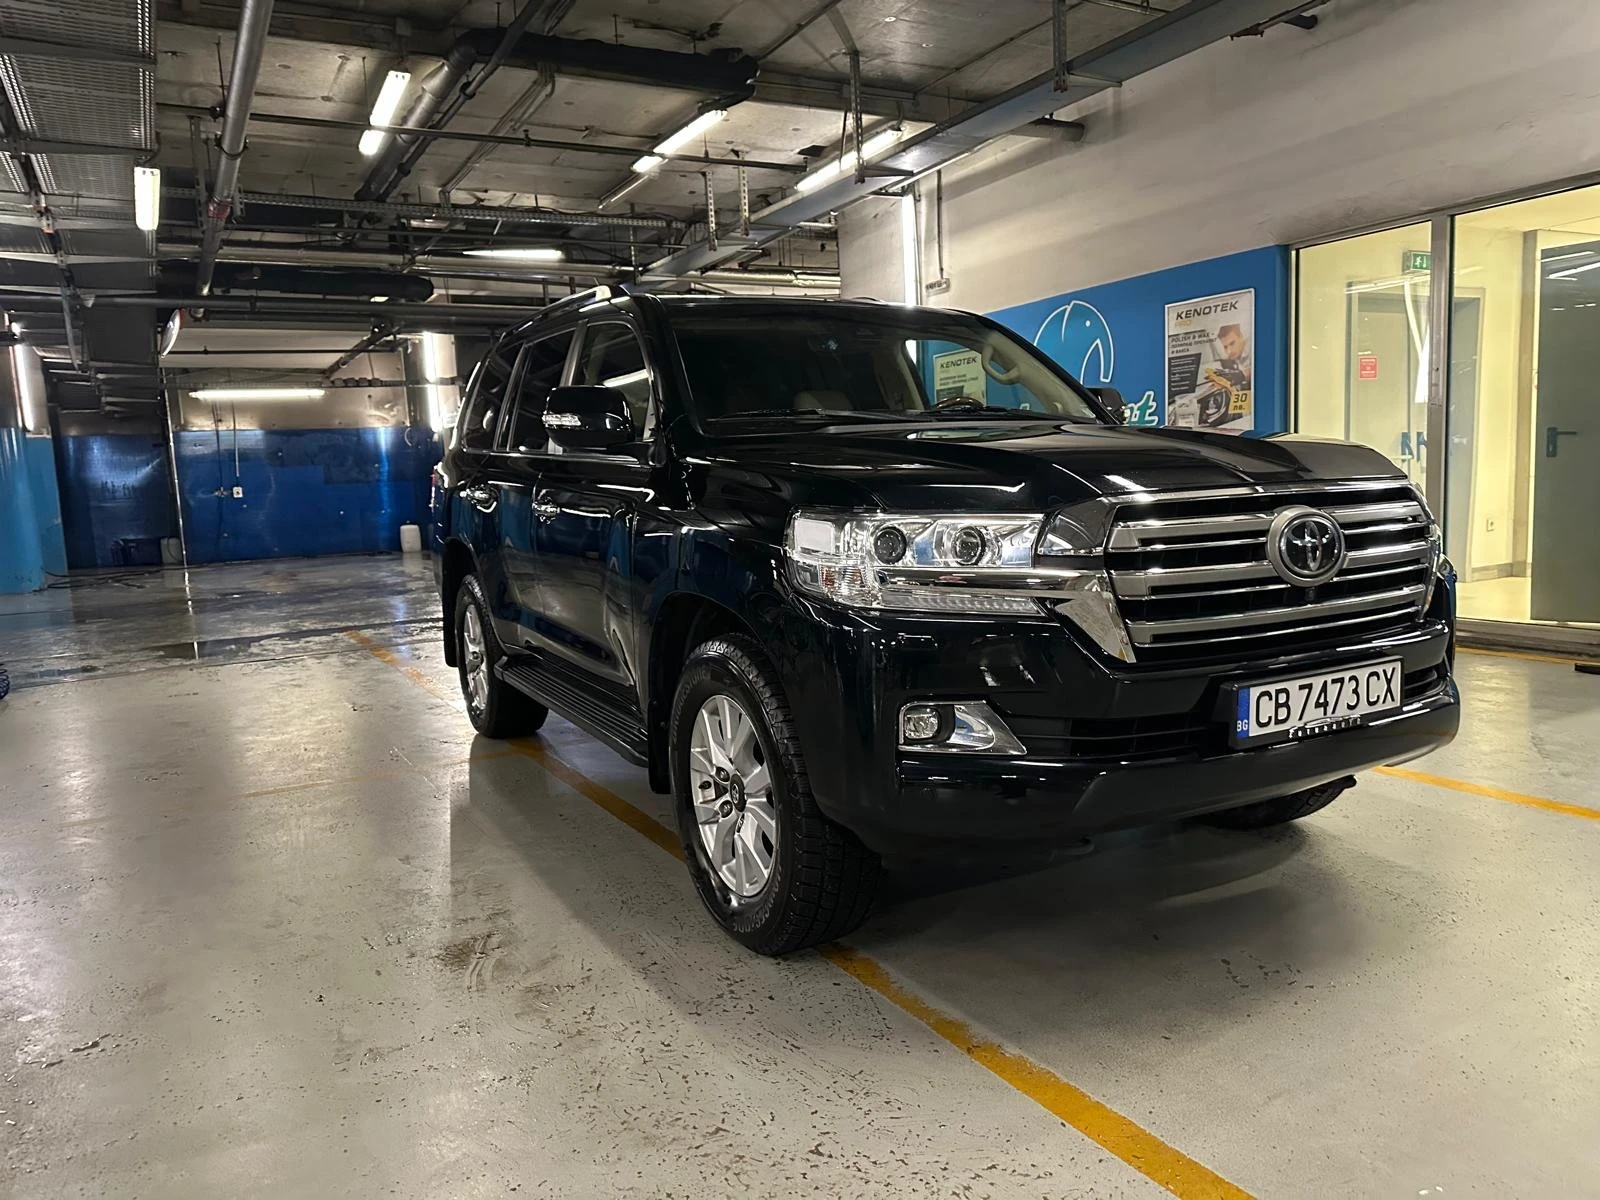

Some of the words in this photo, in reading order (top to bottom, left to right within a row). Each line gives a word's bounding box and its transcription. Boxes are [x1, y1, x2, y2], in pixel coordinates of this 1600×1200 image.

[1176, 301, 1238, 320] KENOTEK
[940, 357, 977, 369] KENOTEK
[1233, 393, 1247, 403] 30
[1255, 687, 1291, 728] CB
[1298, 675, 1360, 721] 7473
[1366, 667, 1396, 706] CX
[1236, 719, 1248, 732] BG
